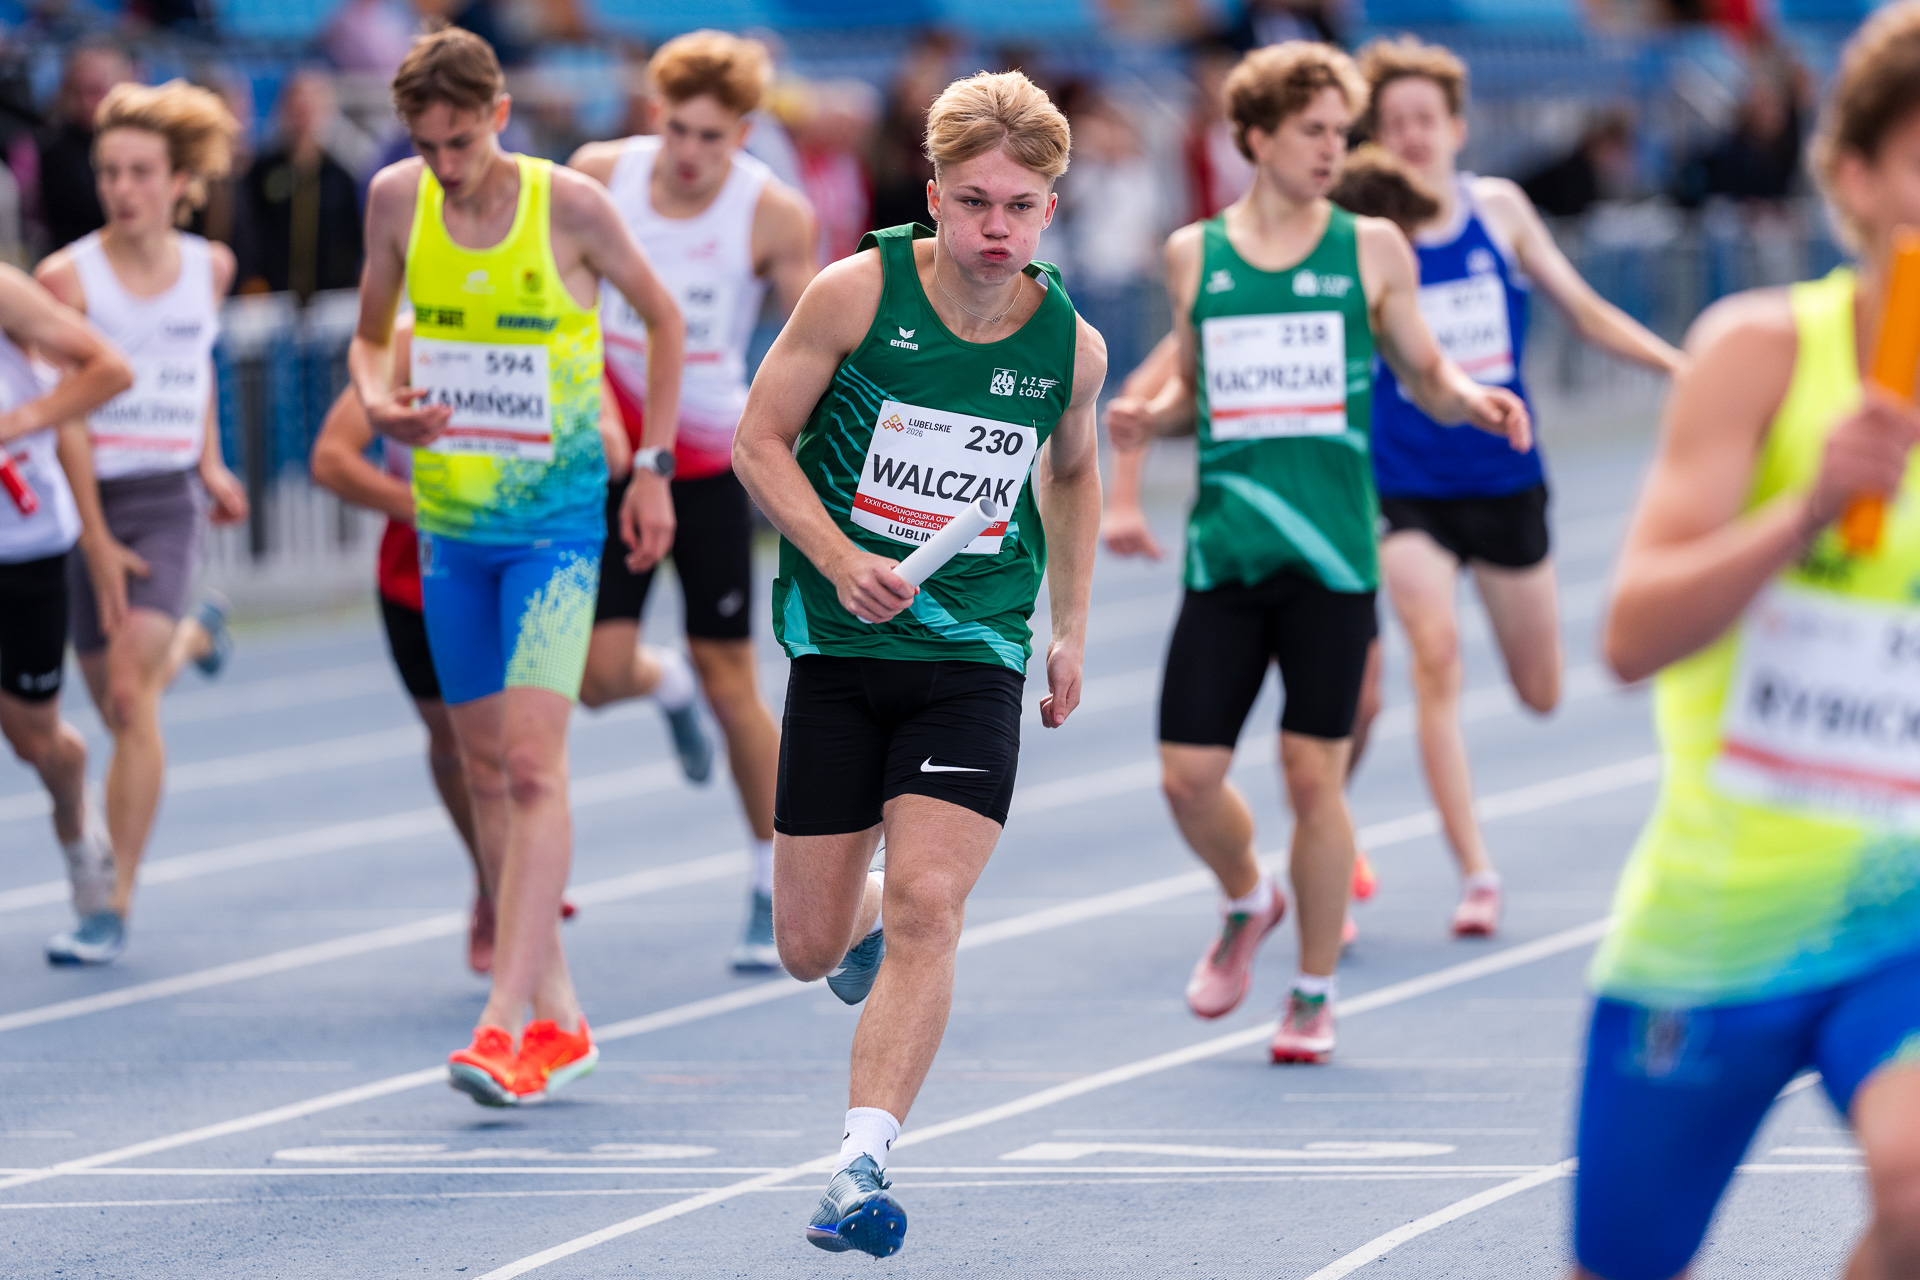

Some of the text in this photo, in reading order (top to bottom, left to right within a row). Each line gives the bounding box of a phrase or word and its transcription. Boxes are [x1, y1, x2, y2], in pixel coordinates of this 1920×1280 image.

[890, 338, 919, 351] erima
[485, 351, 535, 377] 594
[906, 427, 924, 438] 2026
[908, 418, 952, 433] LUBELSKIE
[964, 425, 1024, 456] 230
[872, 453, 1016, 508] WALCZAK
[864, 497, 881, 507] XXXII
[882, 502, 935, 522] OGÓLNOPOLSKA
[888, 523, 935, 543] LUBLIN
[906, 517, 942, 530] SPORTACH
